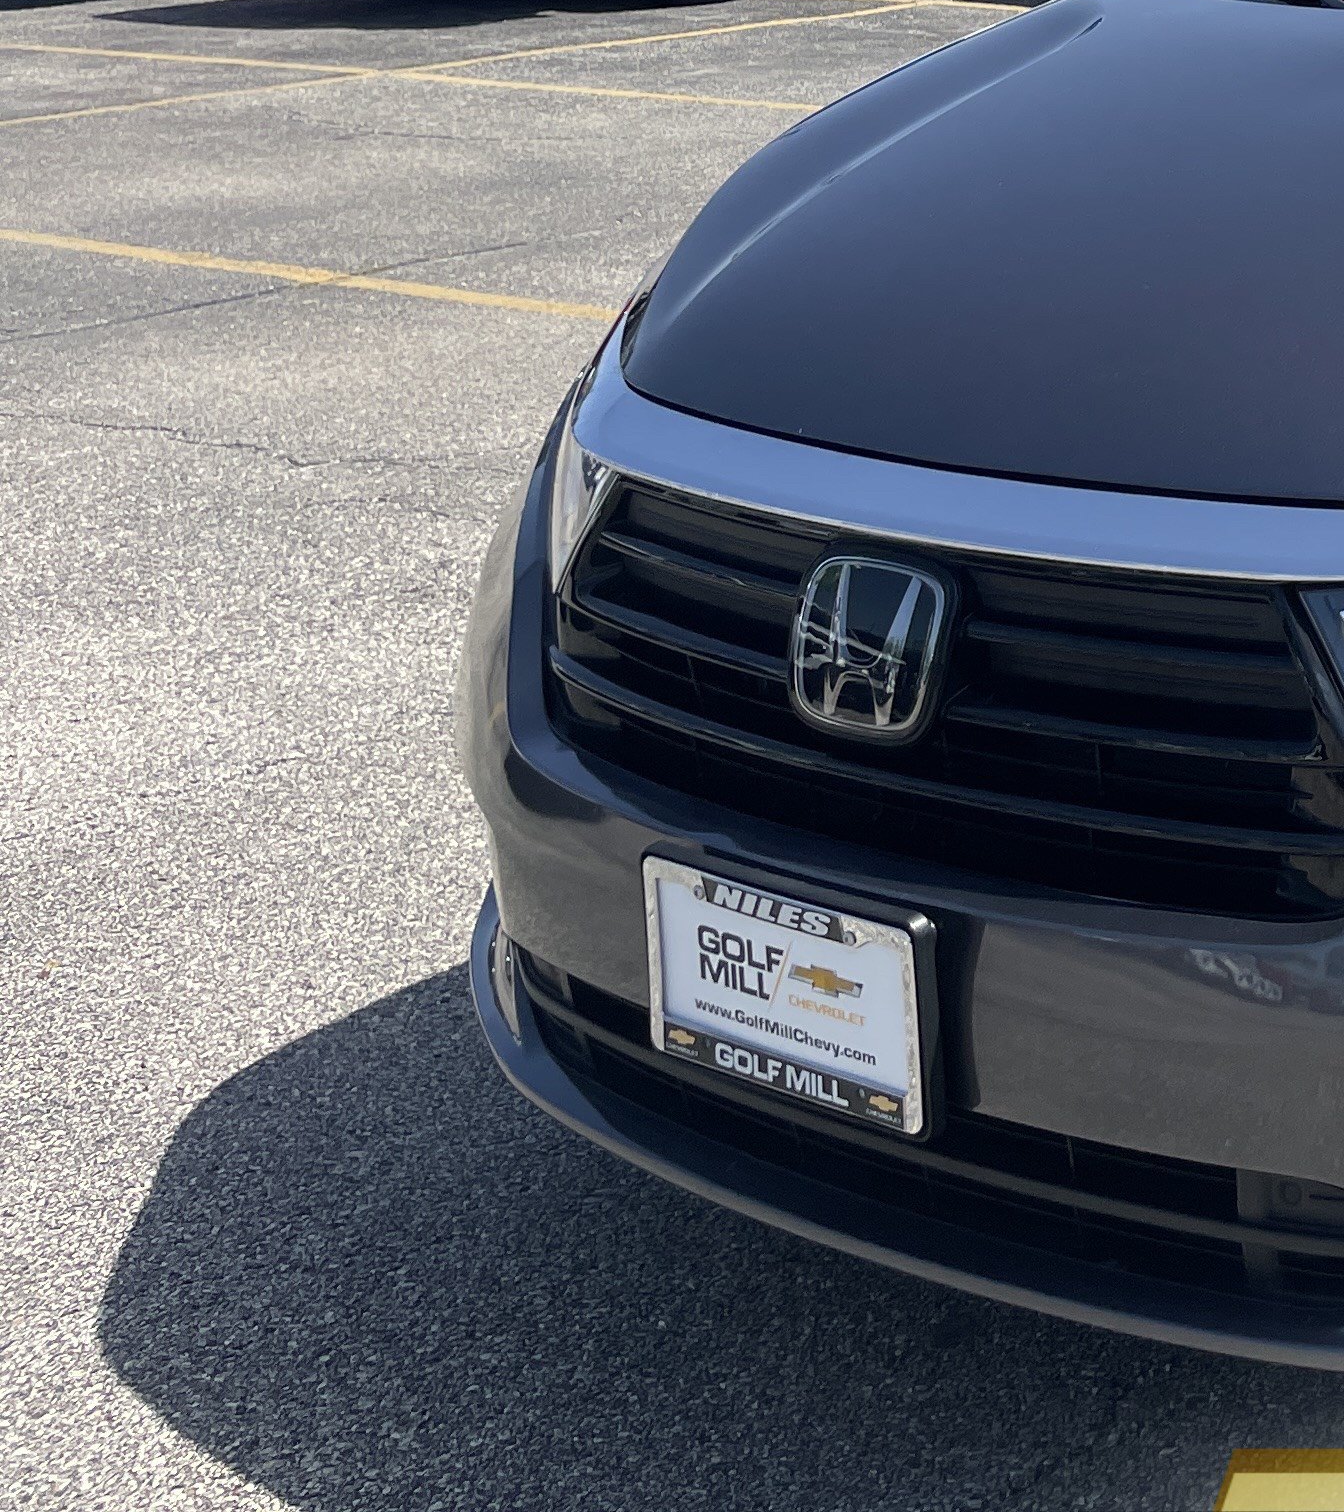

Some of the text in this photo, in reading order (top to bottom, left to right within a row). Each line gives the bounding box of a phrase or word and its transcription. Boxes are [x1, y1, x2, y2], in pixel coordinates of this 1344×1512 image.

[713, 884, 830, 936] NILES
[697, 924, 784, 973] GOLF
[700, 952, 771, 1001] MILL
[695, 997, 877, 1066] www.GolfMillChevy.com
[788, 993, 866, 1027] CHEVROLET
[714, 1042, 850, 1107] GOLF MILL
